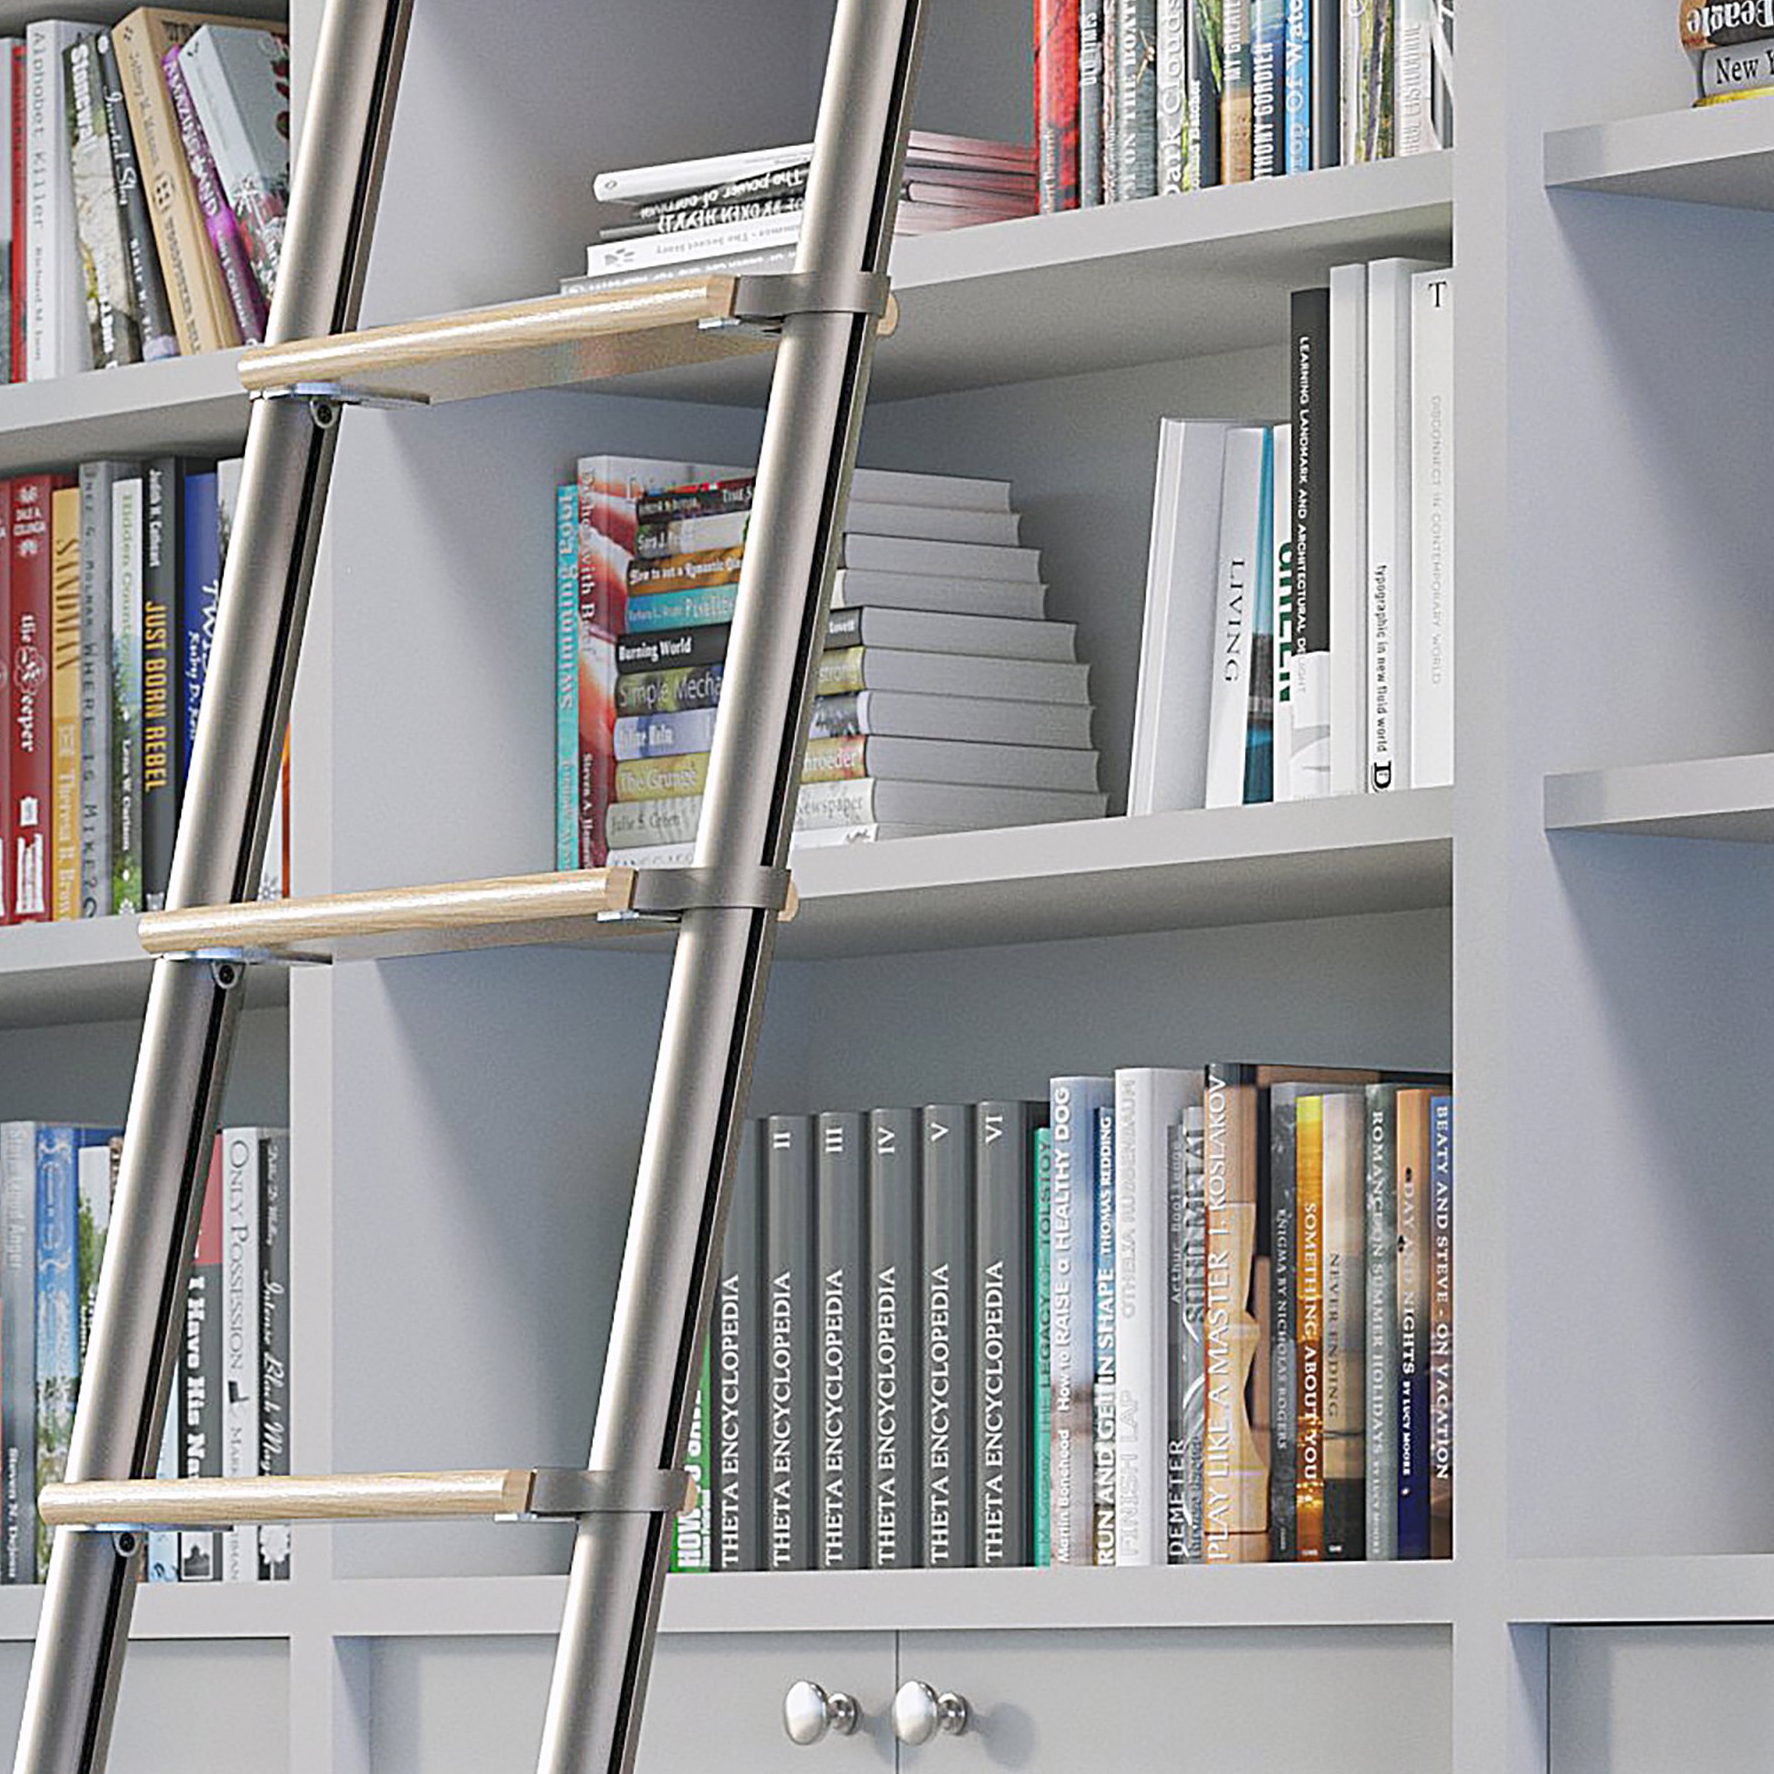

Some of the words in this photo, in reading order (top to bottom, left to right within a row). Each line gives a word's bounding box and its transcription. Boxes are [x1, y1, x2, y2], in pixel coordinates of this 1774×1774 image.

[1715, 55, 1759, 84] New
[144, 600, 166, 652] JUST
[1224, 559, 1246, 683] LIVING
[1373, 566, 1389, 638] typographic
[619, 641, 658, 662] Burning
[660, 636, 691, 655] World
[1377, 641, 1388, 654] in
[1377, 658, 1387, 683] new
[144, 658, 166, 718] BORN
[144, 726, 166, 791] REBEL
[1377, 718, 1388, 752] world
[1054, 1087, 1074, 1141] DOG
[1436, 1106, 1448, 1172] BEATY
[1054, 1145, 1074, 1250] HEALTHY
[1436, 1183, 1448, 1230] AND
[1304, 1202, 1317, 1338] SOMETHING
[1436, 1235, 1448, 1302] STEVE
[1054, 1272, 1074, 1346] RAISE
[1207, 1253, 1229, 1376] MASTER
[1436, 1324, 1449, 1354] ON
[825, 1269, 843, 1472] ENCYCLOPEDIA
[878, 1267, 896, 1470] ENCYCLOPEDIA
[931, 1264, 949, 1467] ENCYCLOPEDIA
[985, 1261, 1004, 1466] ENCYCLOPEDIA
[1207, 1384, 1229, 1408] A
[1304, 1346, 1317, 1416] ABOUT
[1207, 1416, 1229, 1479] LIKE
[1304, 1429, 1317, 1480] YOU
[1435, 1363, 1449, 1479] VACATION
[825, 1479, 843, 1567] THETA
[878, 1478, 896, 1566] THETA
[931, 1477, 949, 1564] THETA
[985, 1475, 1004, 1564] THETA
[1207, 1491, 1229, 1561] PLAY
